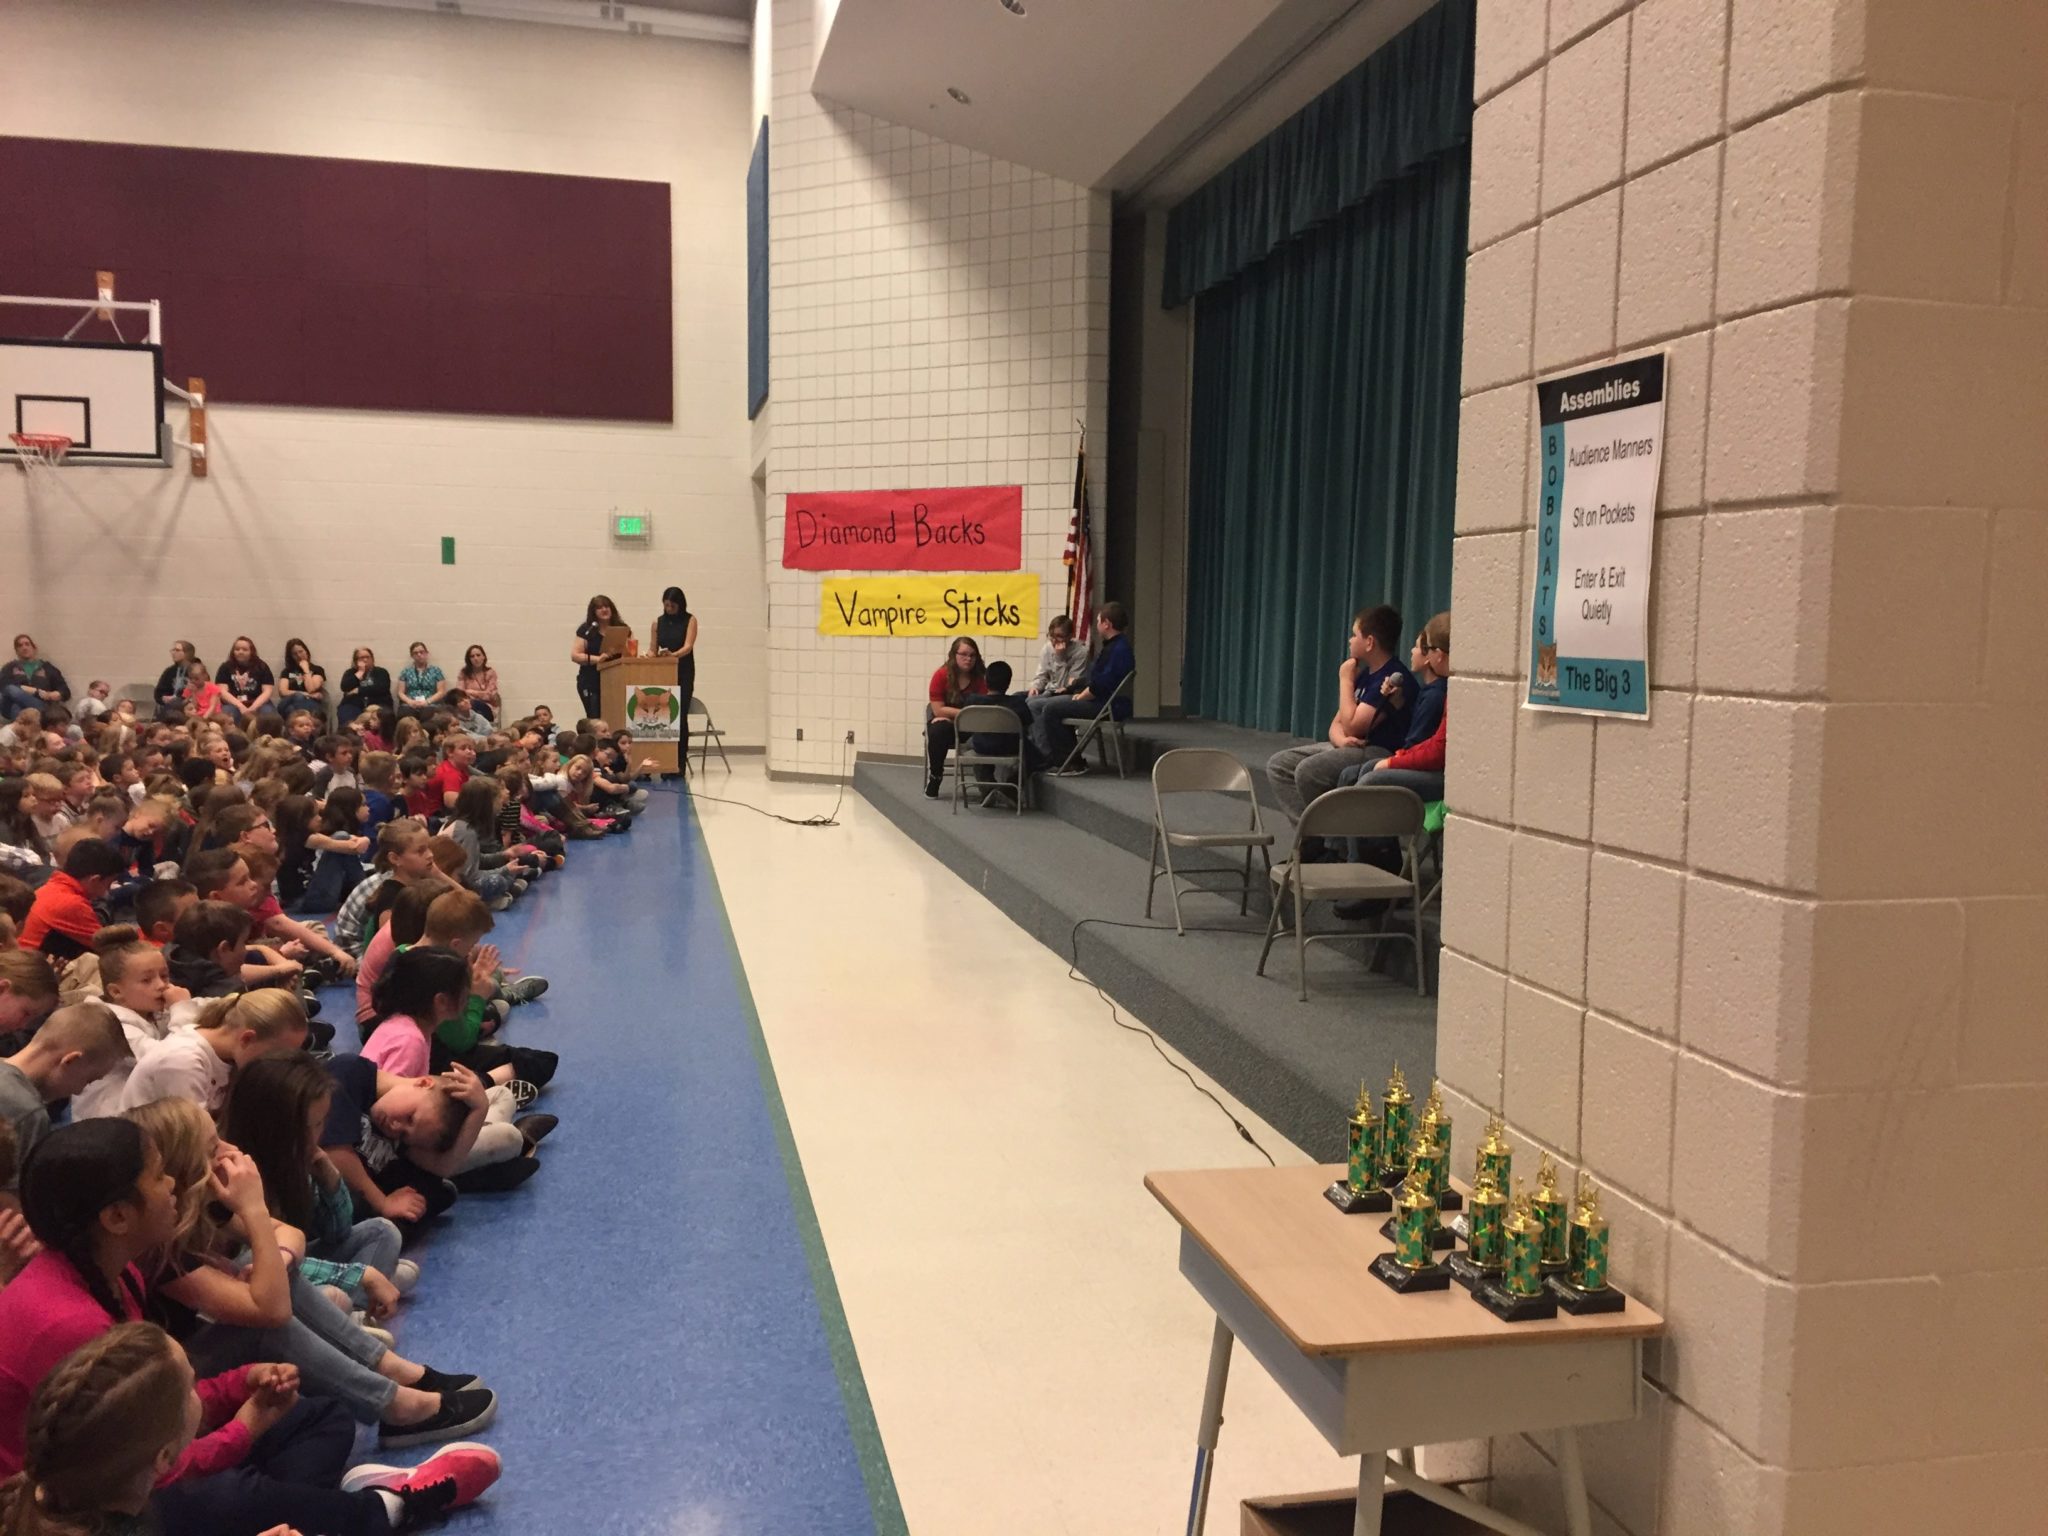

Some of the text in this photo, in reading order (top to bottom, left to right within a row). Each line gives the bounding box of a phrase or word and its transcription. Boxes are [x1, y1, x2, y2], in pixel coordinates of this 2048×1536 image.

[1560, 377, 1641, 413] Assemblies
[1568, 437, 1654, 468] Audience Manners
[796, 503, 986, 549] Diamond Backs
[1572, 503, 1636, 528] Sit on Pockets
[1574, 566, 1626, 589] Enter & Exit
[835, 588, 1021, 635] Vampire Sticks
[1581, 599, 1613, 625] Quietly
[1565, 666, 1631, 700] The Big 3
